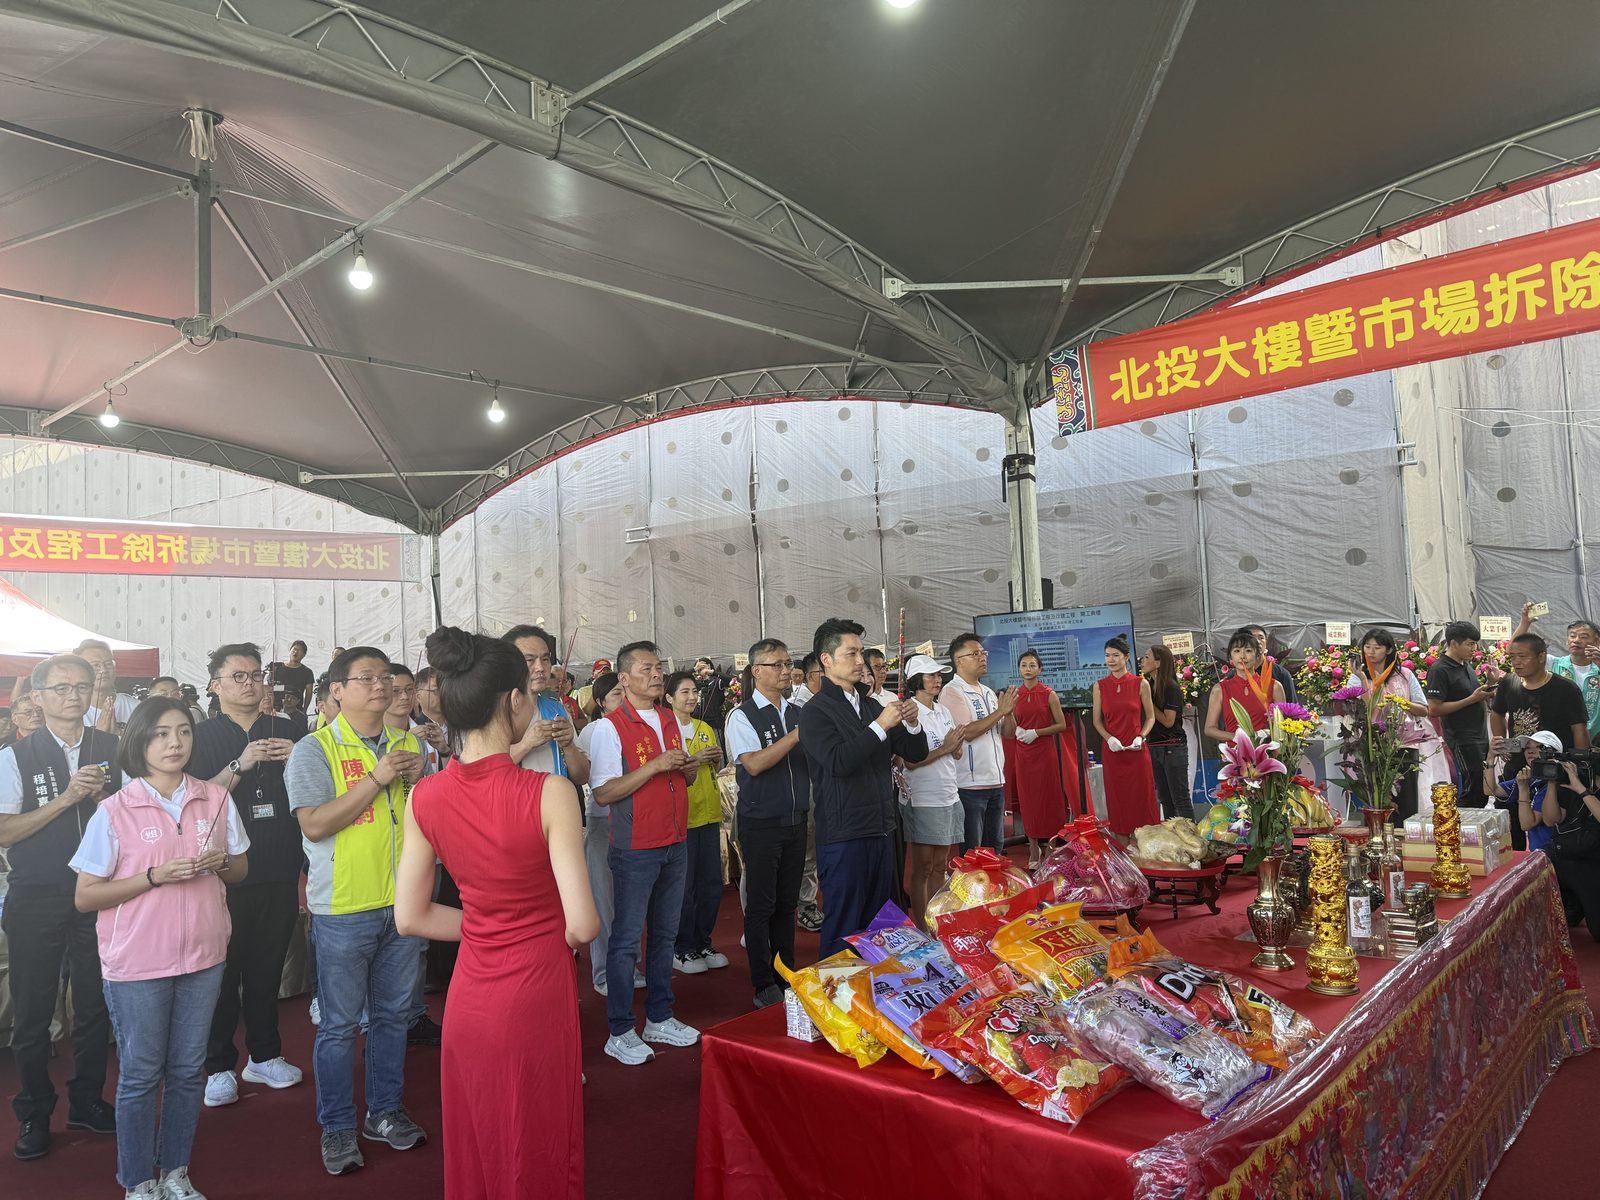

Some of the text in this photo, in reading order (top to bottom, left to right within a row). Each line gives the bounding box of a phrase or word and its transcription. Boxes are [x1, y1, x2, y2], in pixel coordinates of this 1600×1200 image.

[1109, 250, 1600, 404] 北投大樓暨市場拆除
